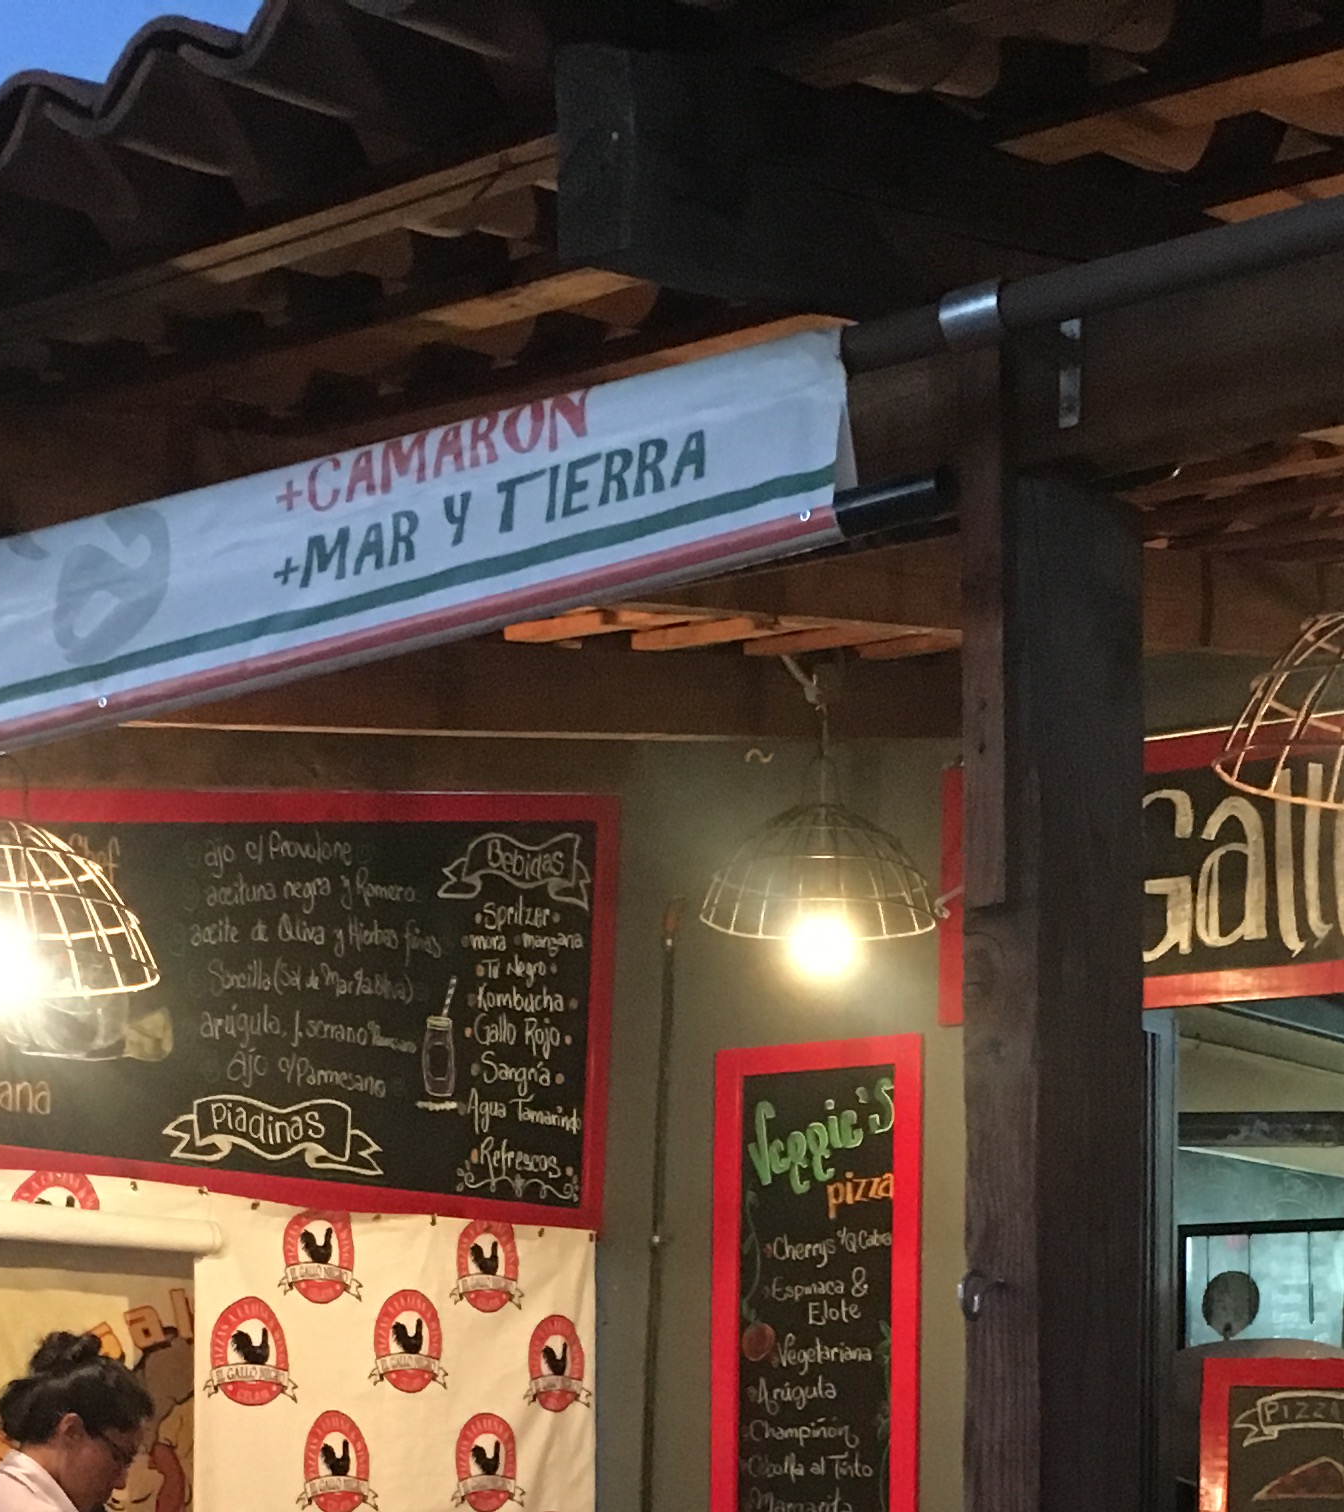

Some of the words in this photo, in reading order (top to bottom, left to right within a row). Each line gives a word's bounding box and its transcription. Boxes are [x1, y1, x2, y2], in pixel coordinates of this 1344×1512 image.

[443, 490, 471, 546] Y
[497, 428, 707, 533] TIERRA
[486, 839, 565, 880] Bebidas
[283, 876, 331, 915] negra
[482, 896, 551, 931] Spritzer
[476, 982, 564, 1013] Kombucha
[473, 1012, 517, 1046] Gallo
[524, 1016, 561, 1060] Rojo
[480, 1050, 551, 1097] Sangría
[210, 1102, 328, 1147] Piadinas
[467, 1087, 507, 1134] Agua
[510, 1094, 583, 1134] Tamarindo
[480, 1136, 562, 1181] Refrescos
[826, 1171, 895, 1219] pizza
[773, 1234, 837, 1268] Cherrys
[851, 1266, 869, 1298] &
[808, 1299, 863, 1326] Elote
[777, 1333, 873, 1376] Vegetariana
[809, 1456, 825, 1476] al
